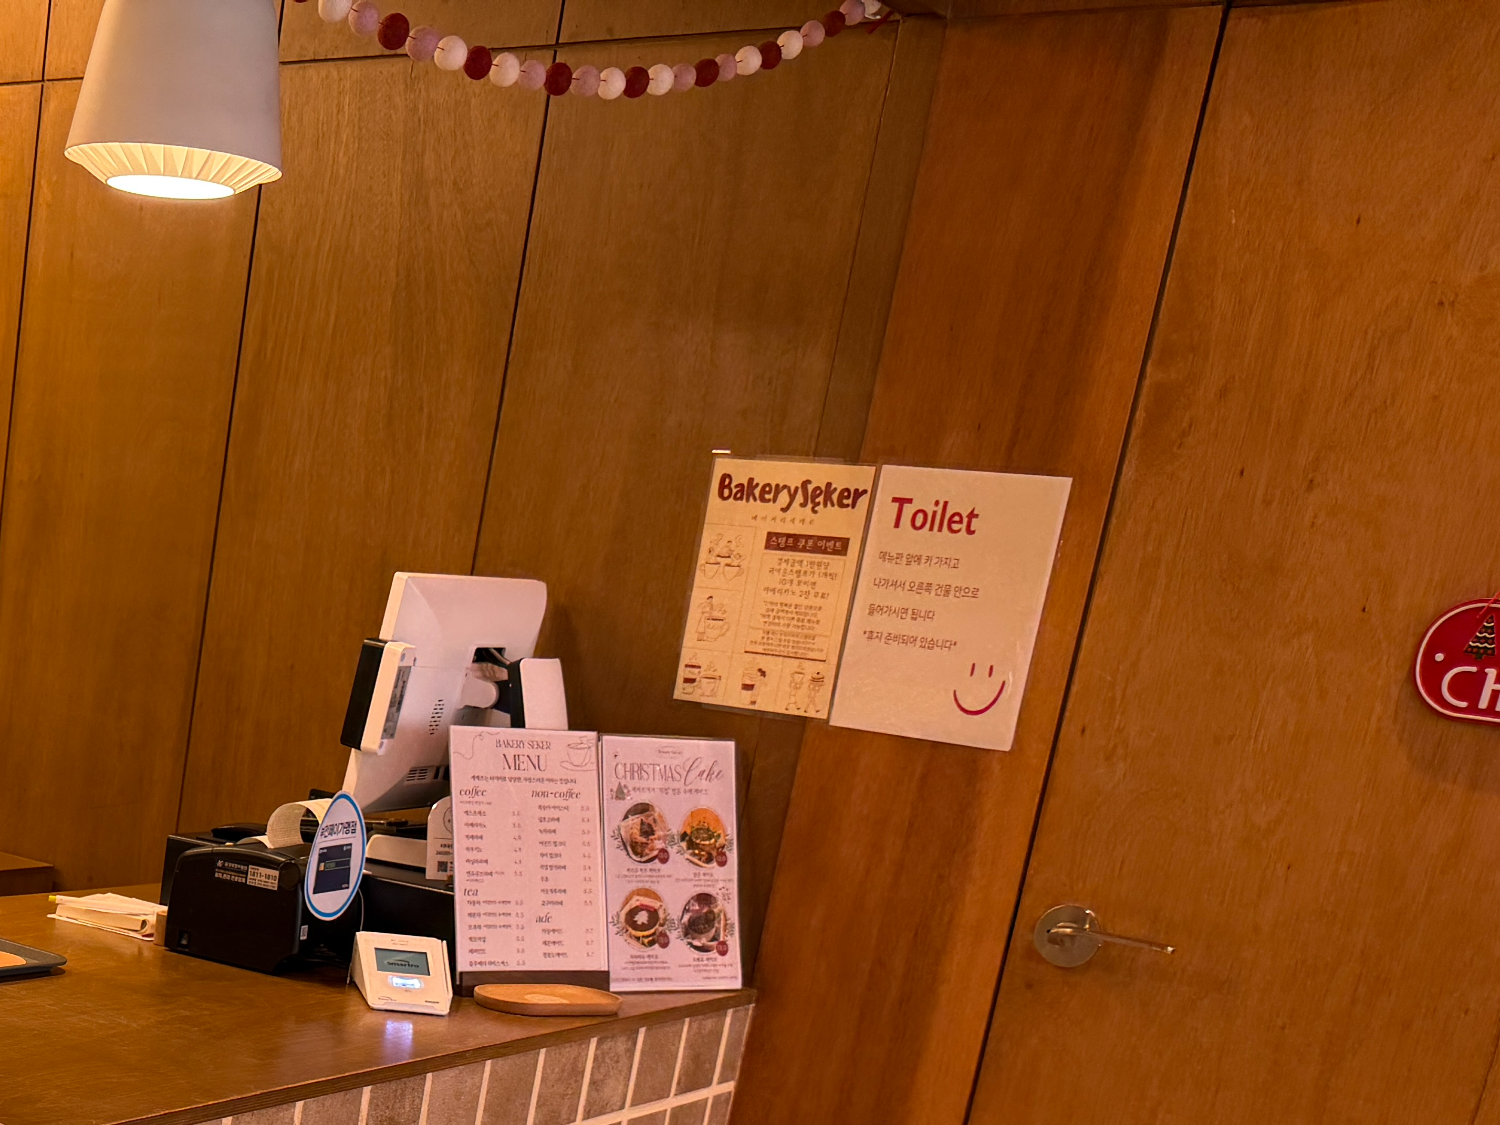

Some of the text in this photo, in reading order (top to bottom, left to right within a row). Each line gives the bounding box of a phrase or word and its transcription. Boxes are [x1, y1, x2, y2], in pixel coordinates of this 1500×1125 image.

[891, 496, 980, 536] Toilet
[797, 539, 842, 552] 쿠폰 이벤트
[877, 550, 961, 570] 메뉴판 앞에 키 가지고
[873, 577, 980, 599] 나가셔서 오른쪽 건물 안으로
[867, 603, 936, 622] 들어가시면 됩니다
[883, 633, 918, 648] 준비되어
[495, 738, 552, 750] BAKERY SEKER
[502, 753, 547, 772] MENU
[614, 756, 724, 787] CHRISTMAS Cake
[459, 785, 487, 799] coffee
[531, 787, 581, 801] non-coffee
[463, 888, 479, 897] tea
